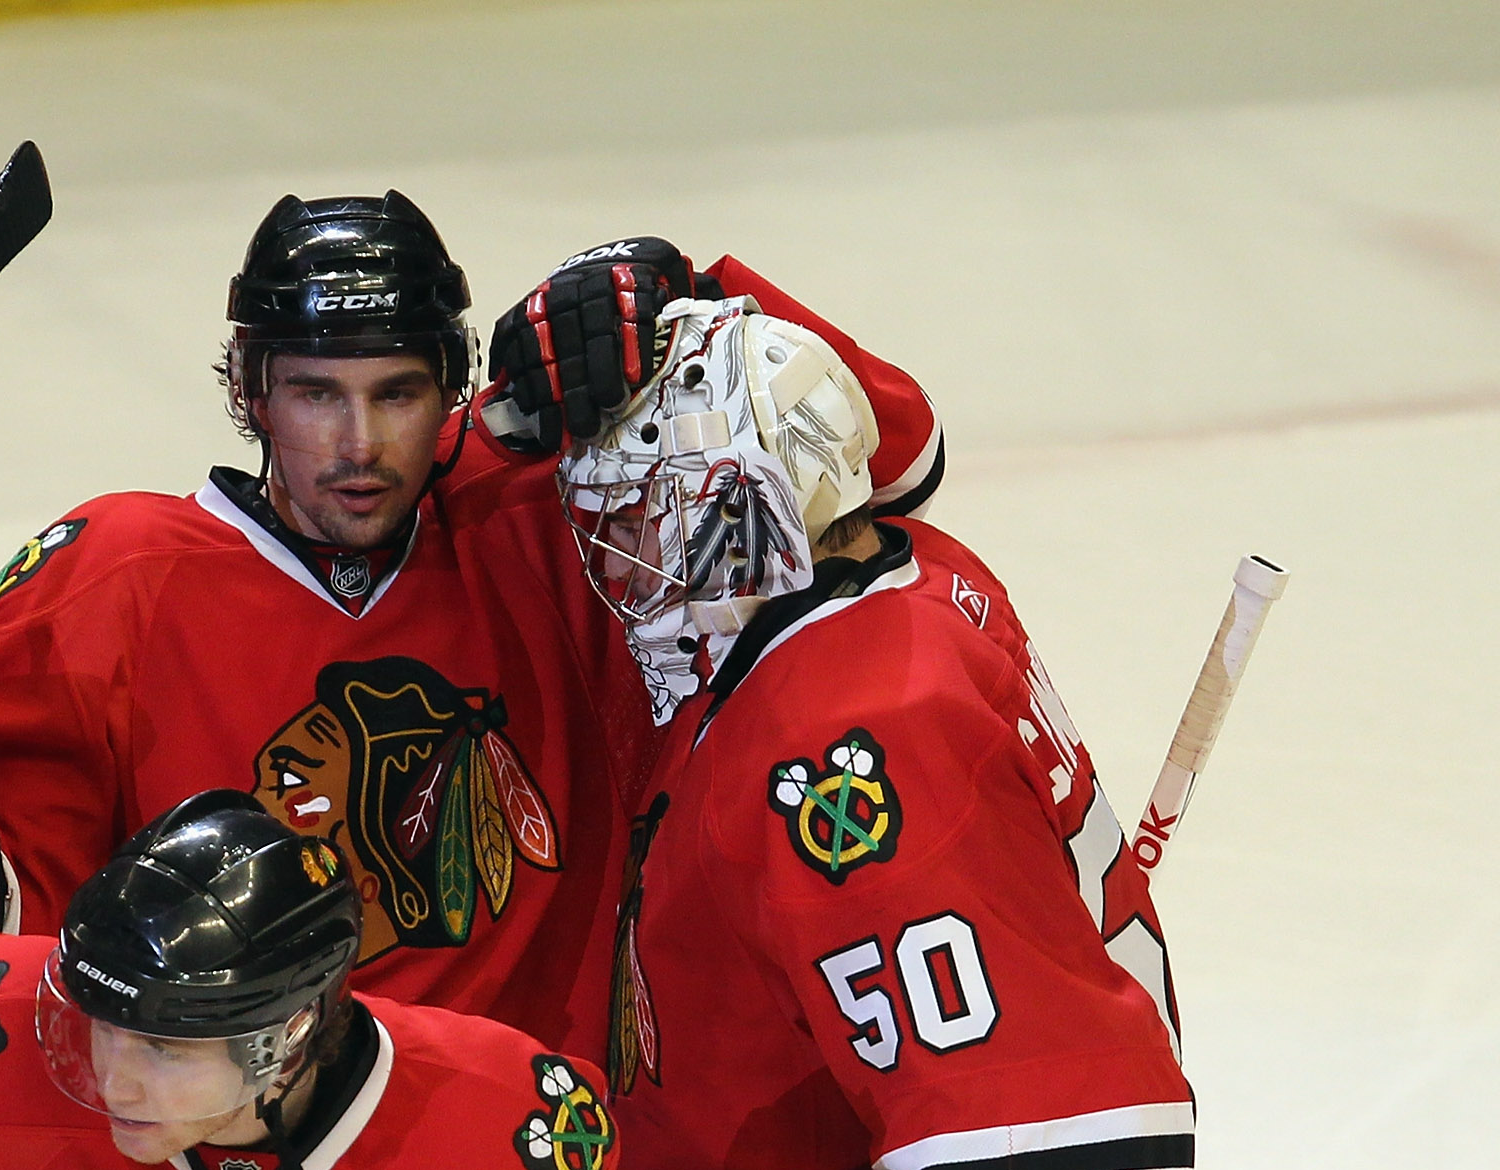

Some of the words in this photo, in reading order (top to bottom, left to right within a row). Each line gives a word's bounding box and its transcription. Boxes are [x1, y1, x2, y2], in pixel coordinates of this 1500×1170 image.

[315, 292, 398, 311] CCM
[76, 960, 141, 999] BAUER
[815, 908, 1001, 1071] 50
